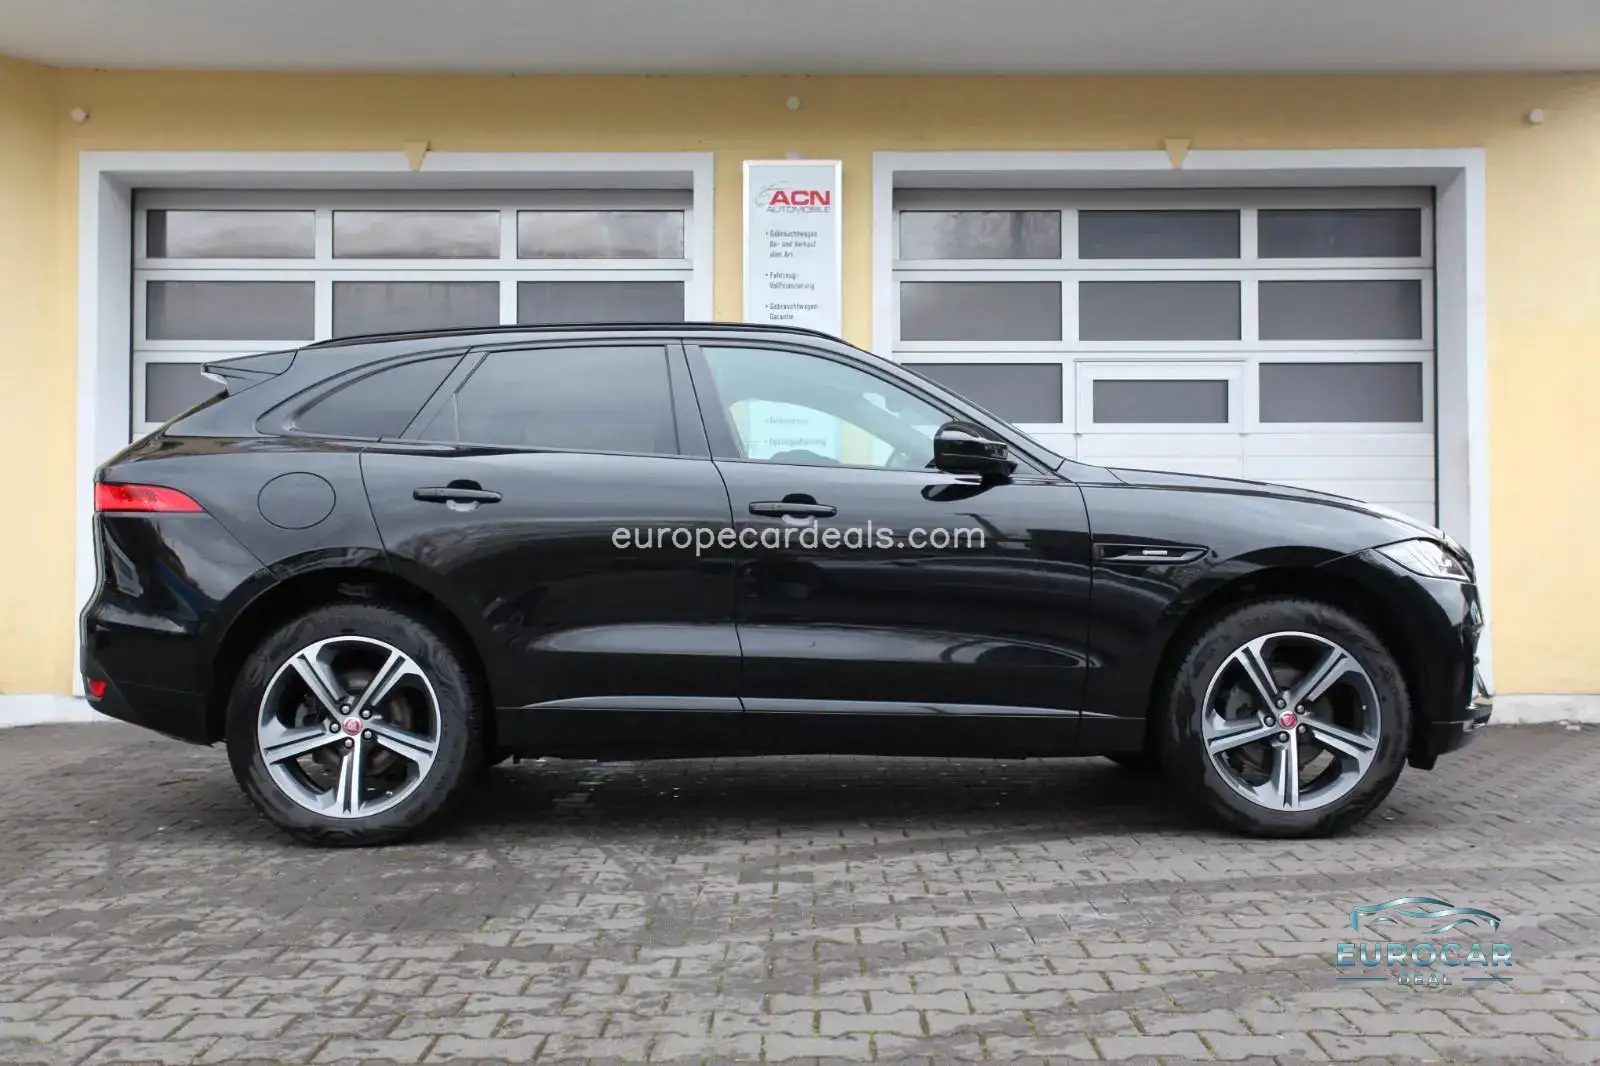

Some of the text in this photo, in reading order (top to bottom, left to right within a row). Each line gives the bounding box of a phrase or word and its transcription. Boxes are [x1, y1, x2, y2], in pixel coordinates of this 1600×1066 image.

[769, 190, 830, 205] ACN
[766, 206, 830, 214] AUTOMOBILE
[769, 229, 818, 240] Gebrauchtwagen
[769, 313, 794, 321] Garantie
